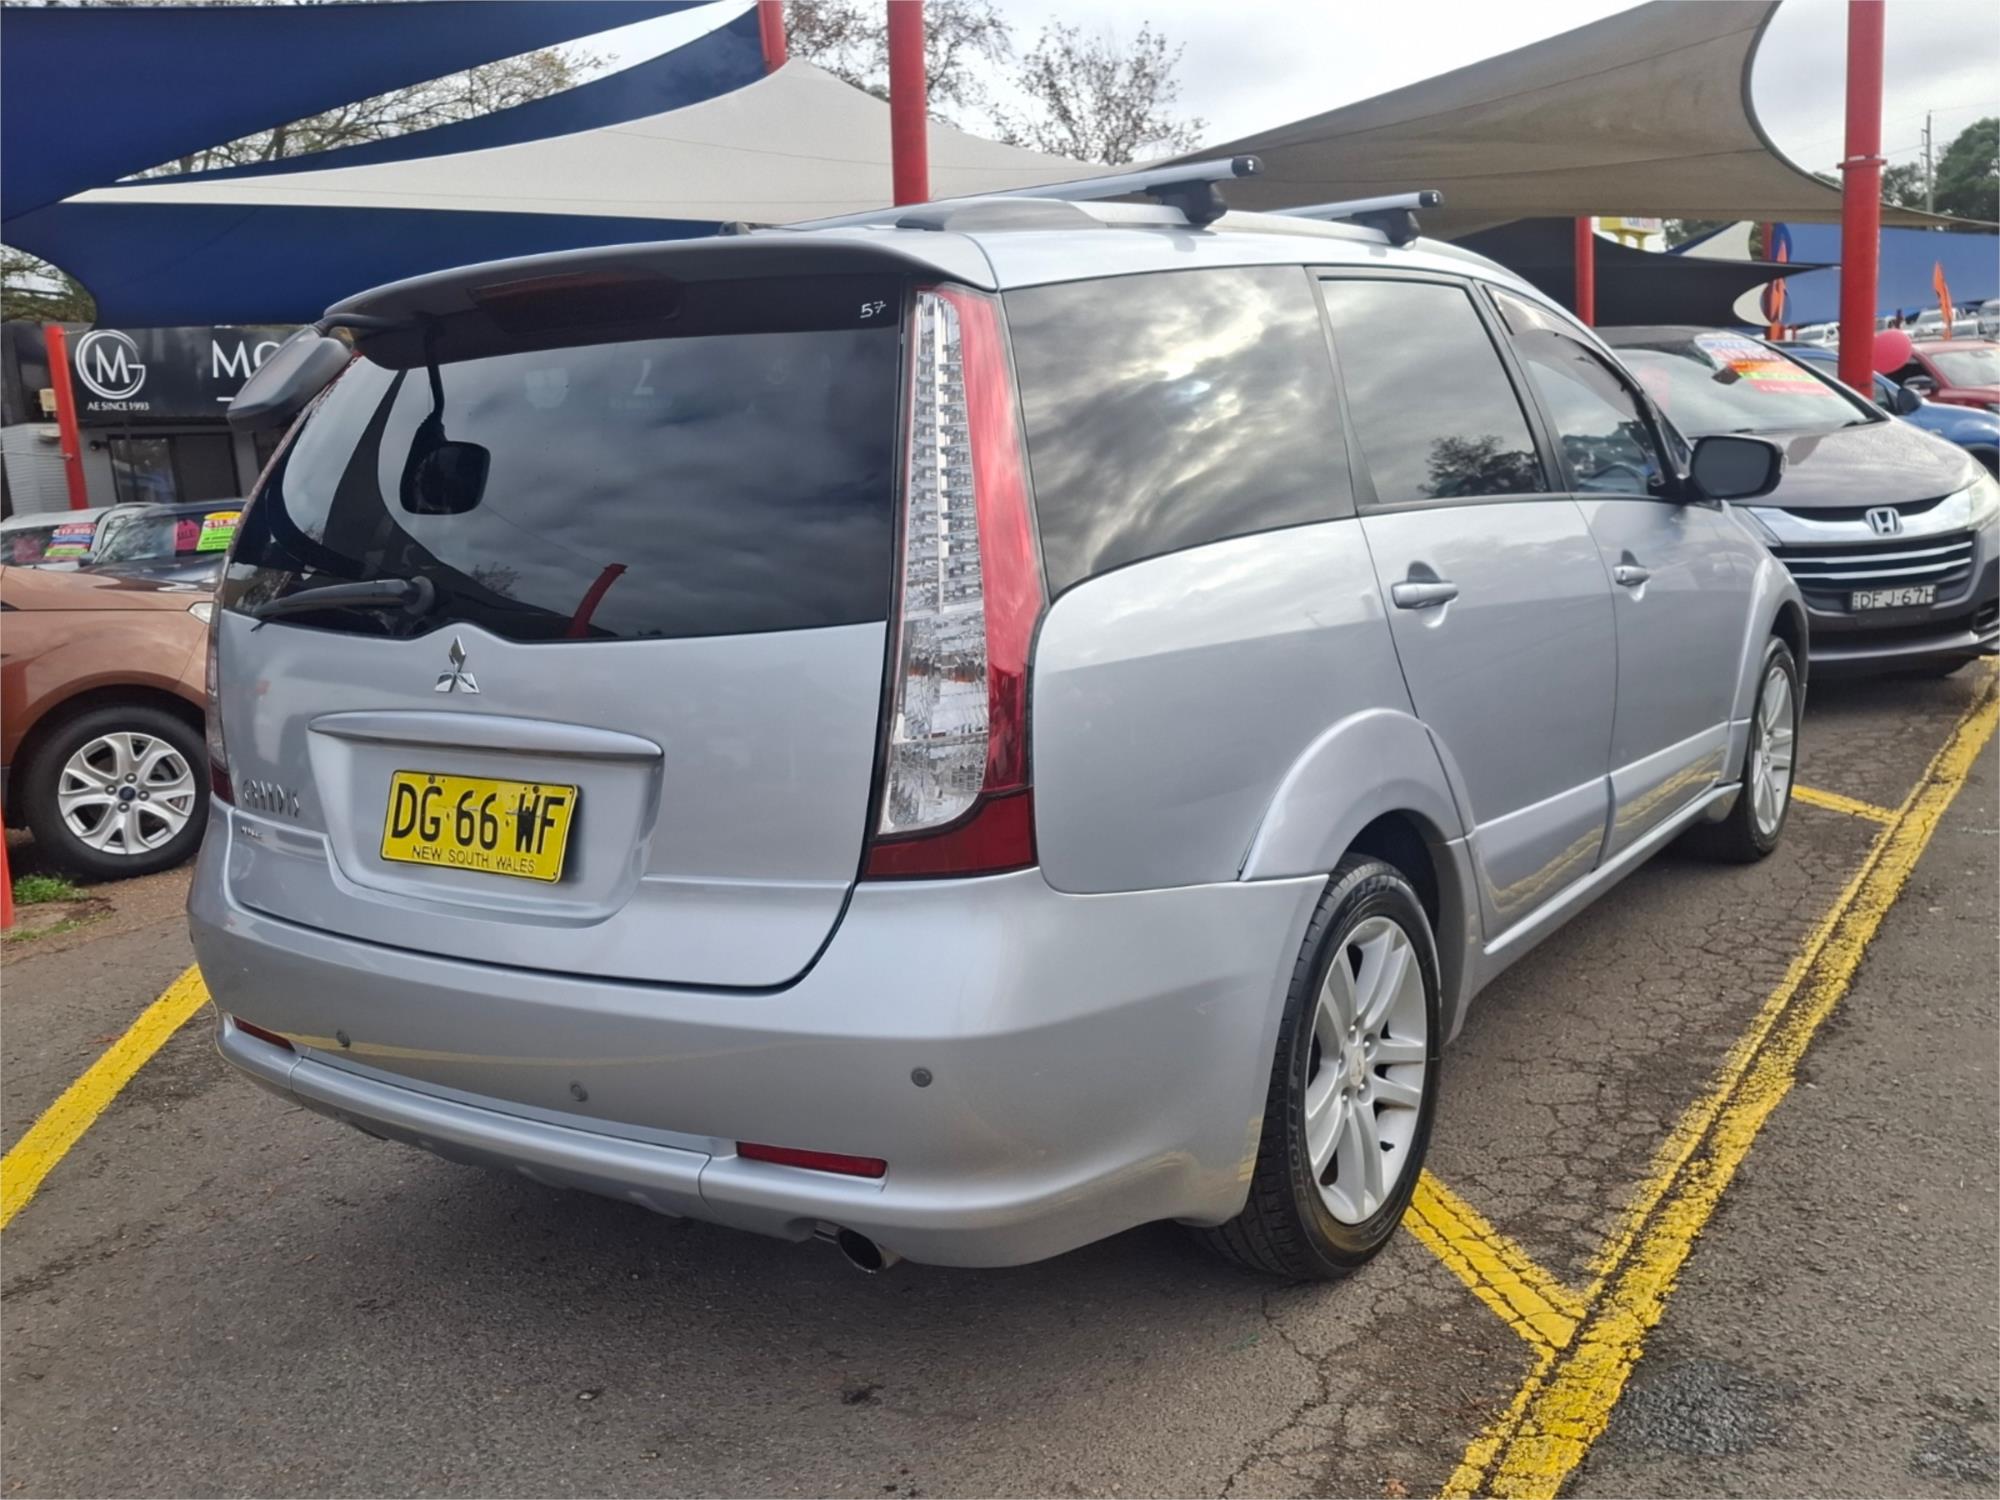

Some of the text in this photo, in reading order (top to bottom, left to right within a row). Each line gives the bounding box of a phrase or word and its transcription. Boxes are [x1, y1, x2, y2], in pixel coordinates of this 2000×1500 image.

[859, 300, 887, 319] 57
[101, 402, 128, 411] SINCE
[455, 790, 499, 851] 66
[411, 844, 536, 874] NEW SOUTH WALES
